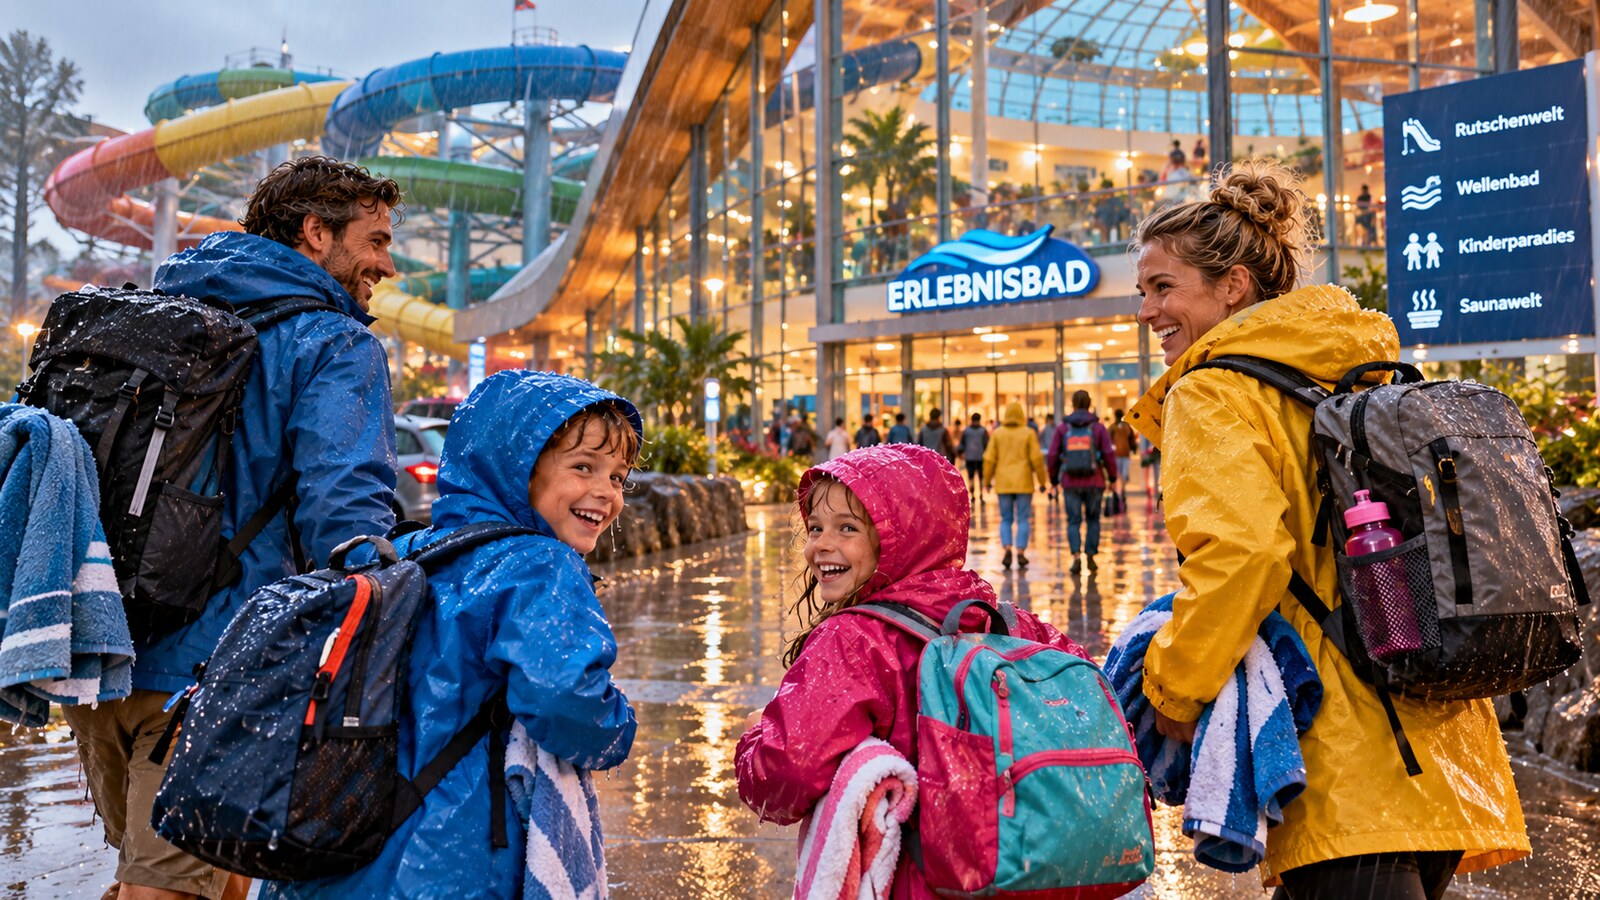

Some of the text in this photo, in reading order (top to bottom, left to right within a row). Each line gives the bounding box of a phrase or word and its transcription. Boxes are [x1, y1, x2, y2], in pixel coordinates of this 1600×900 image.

[1455, 105, 1565, 138] Rutschenwelt
[1456, 169, 1540, 196] Wellenbad
[1458, 228, 1576, 255] Kinderparadies
[887, 260, 1091, 312] ERLEBNISBAD
[1459, 291, 1543, 314] Saunawelt
